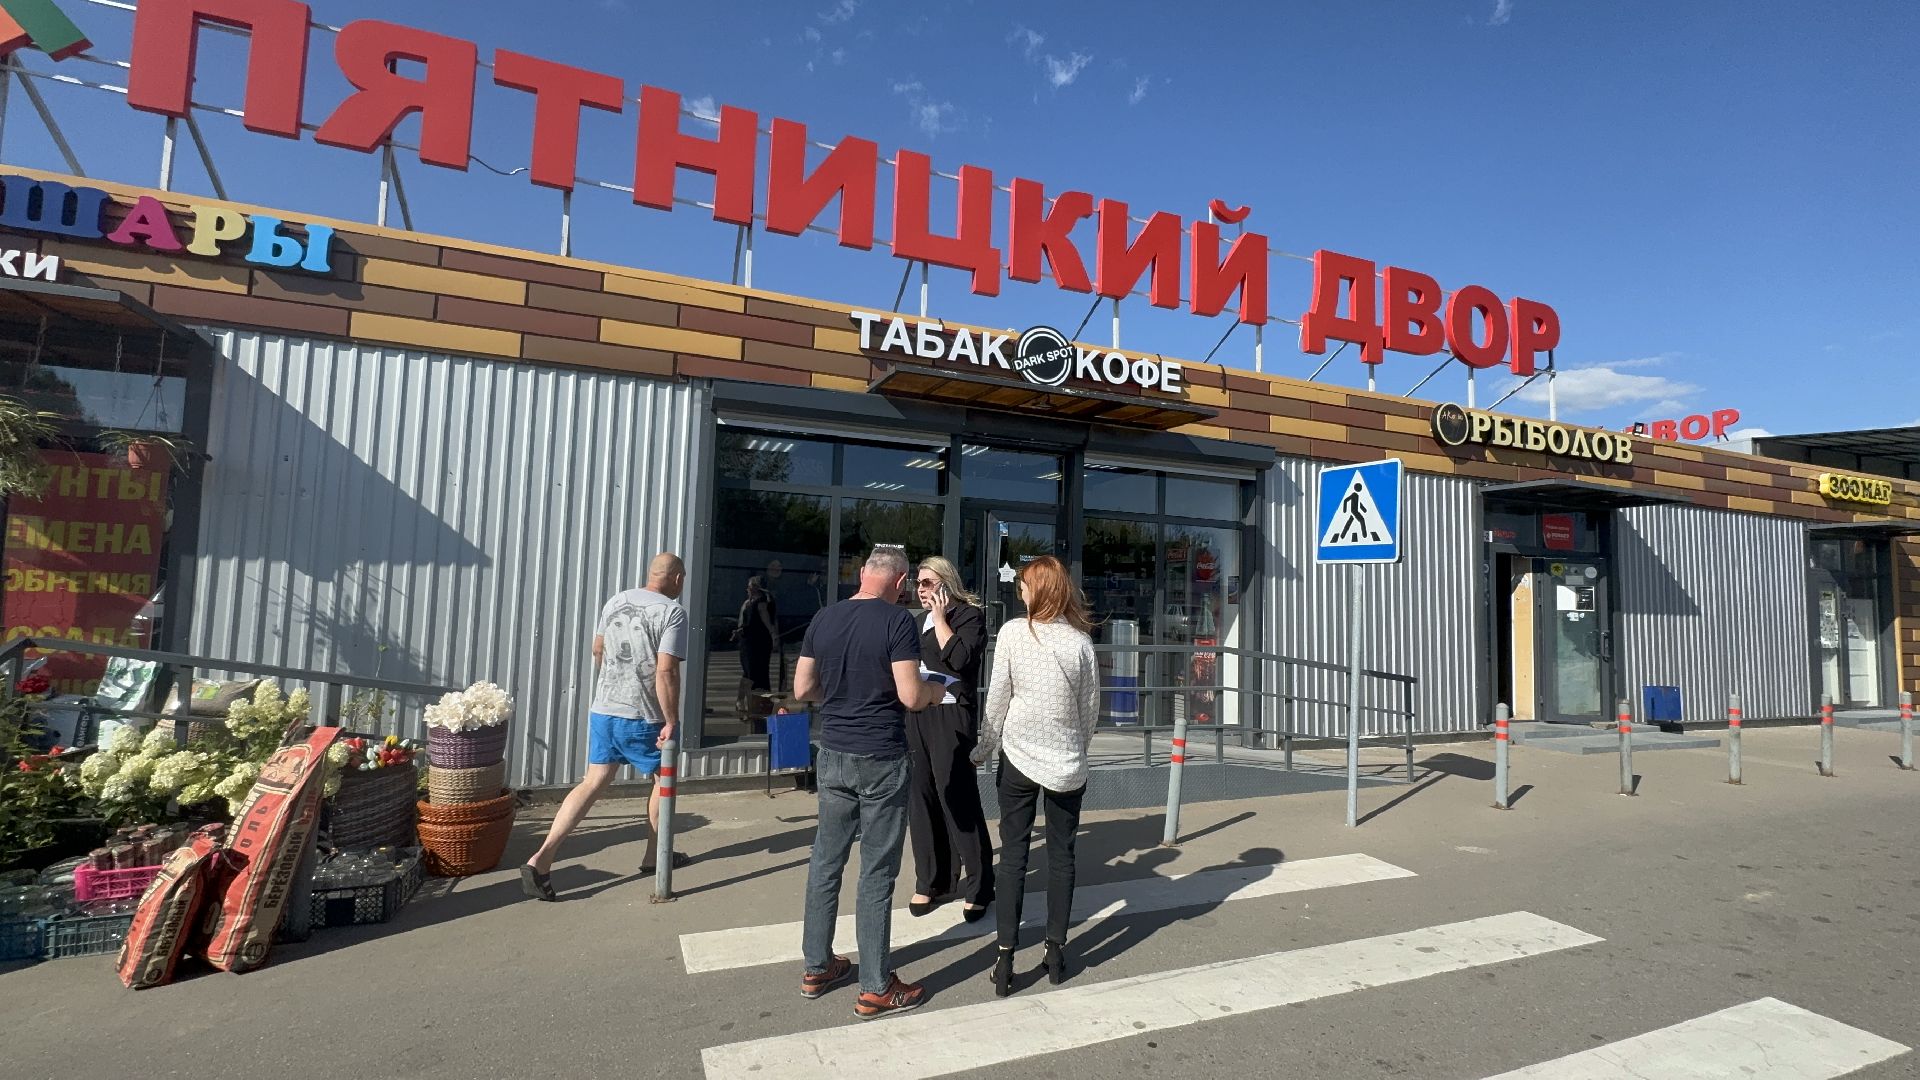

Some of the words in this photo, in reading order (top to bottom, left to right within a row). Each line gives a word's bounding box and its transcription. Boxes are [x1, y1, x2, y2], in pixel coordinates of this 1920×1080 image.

[127, 0, 1268, 326] ПЯТНИЦКИЙ
[1302, 249, 1561, 377] ДВОР
[850, 310, 1011, 371] ТАБАК
[1075, 348, 1182, 394] КОФЕ
[1014, 353, 1045, 371] DARK
[1046, 346, 1073, 362] SPOT
[1470, 411, 1634, 464] РЫБОЛОВ
[1626, 408, 1740, 442] ВОР
[890, 990, 906, 1007] N
